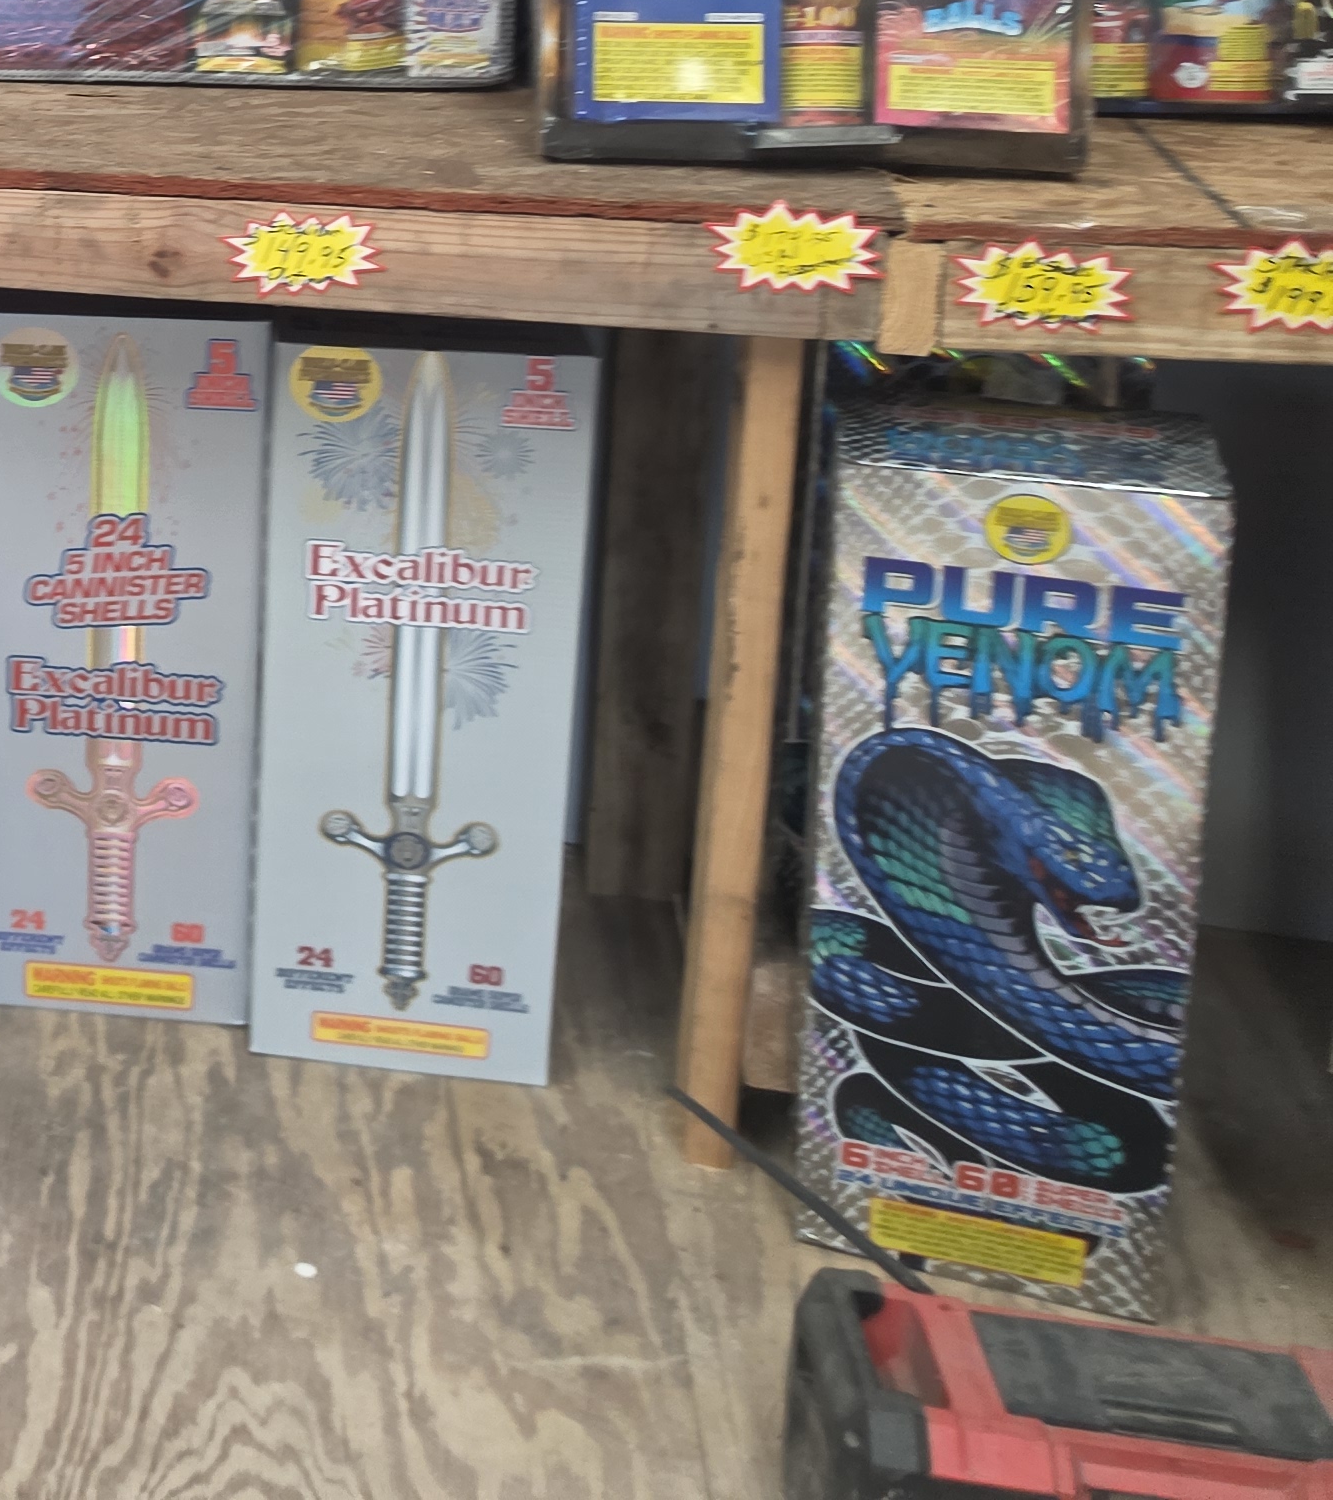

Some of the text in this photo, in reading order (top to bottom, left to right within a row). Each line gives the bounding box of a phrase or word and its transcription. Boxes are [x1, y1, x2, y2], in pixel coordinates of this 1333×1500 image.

[210, 340, 236, 375] 5
[526, 355, 556, 391] 5
[90, 516, 146, 547] 24
[64, 548, 171, 575] 5 INCH
[308, 542, 539, 590] Excalibur
[28, 572, 207, 602] CANNISTER
[56, 601, 176, 626] SHELLS
[309, 583, 528, 632] Platinum
[861, 556, 1187, 652] PURE
[9, 657, 222, 704] Excalibur
[861, 613, 1181, 736] VENOM
[13, 700, 216, 743] Platinum
[9, 908, 47, 931] 24
[295, 945, 335, 968] 24
[468, 963, 504, 987] 60
[841, 1140, 870, 1169] 6
